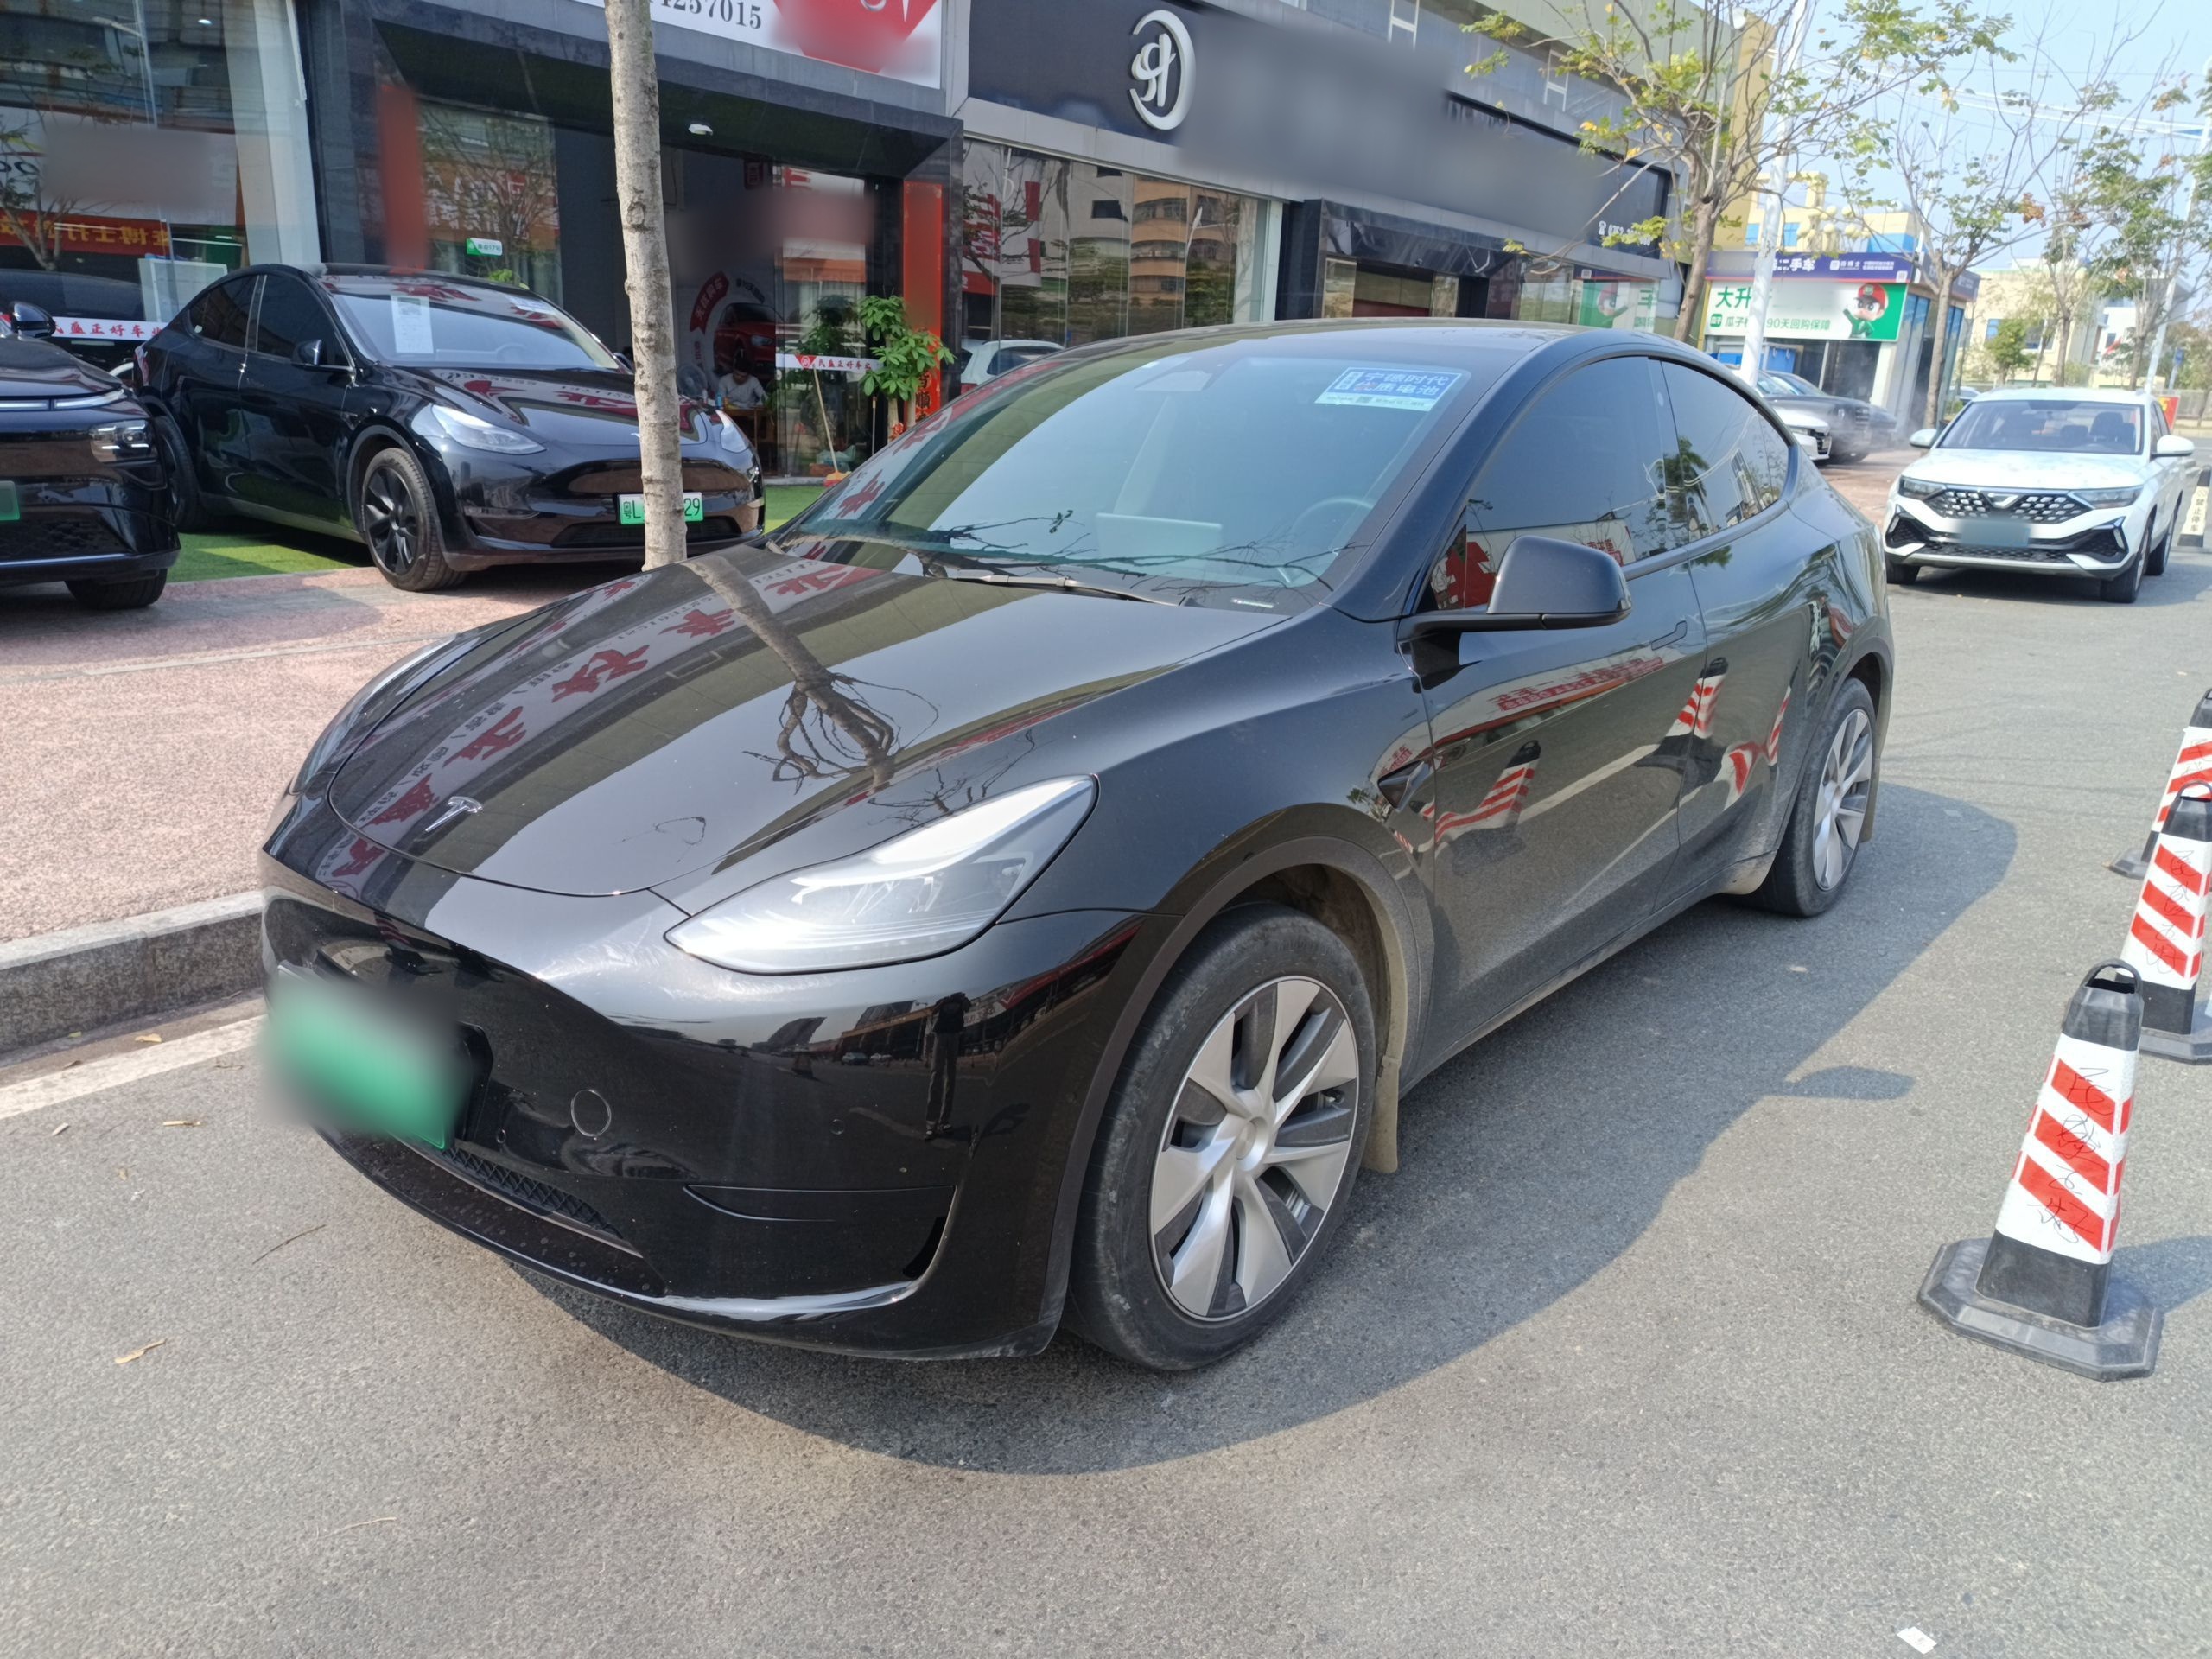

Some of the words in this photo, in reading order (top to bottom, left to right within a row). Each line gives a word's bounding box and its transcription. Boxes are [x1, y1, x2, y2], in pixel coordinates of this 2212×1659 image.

[1766, 317, 1831, 331] 90天回购保障
[1364, 372, 1451, 386] 宁德时代
[683, 497, 701, 517] 29
